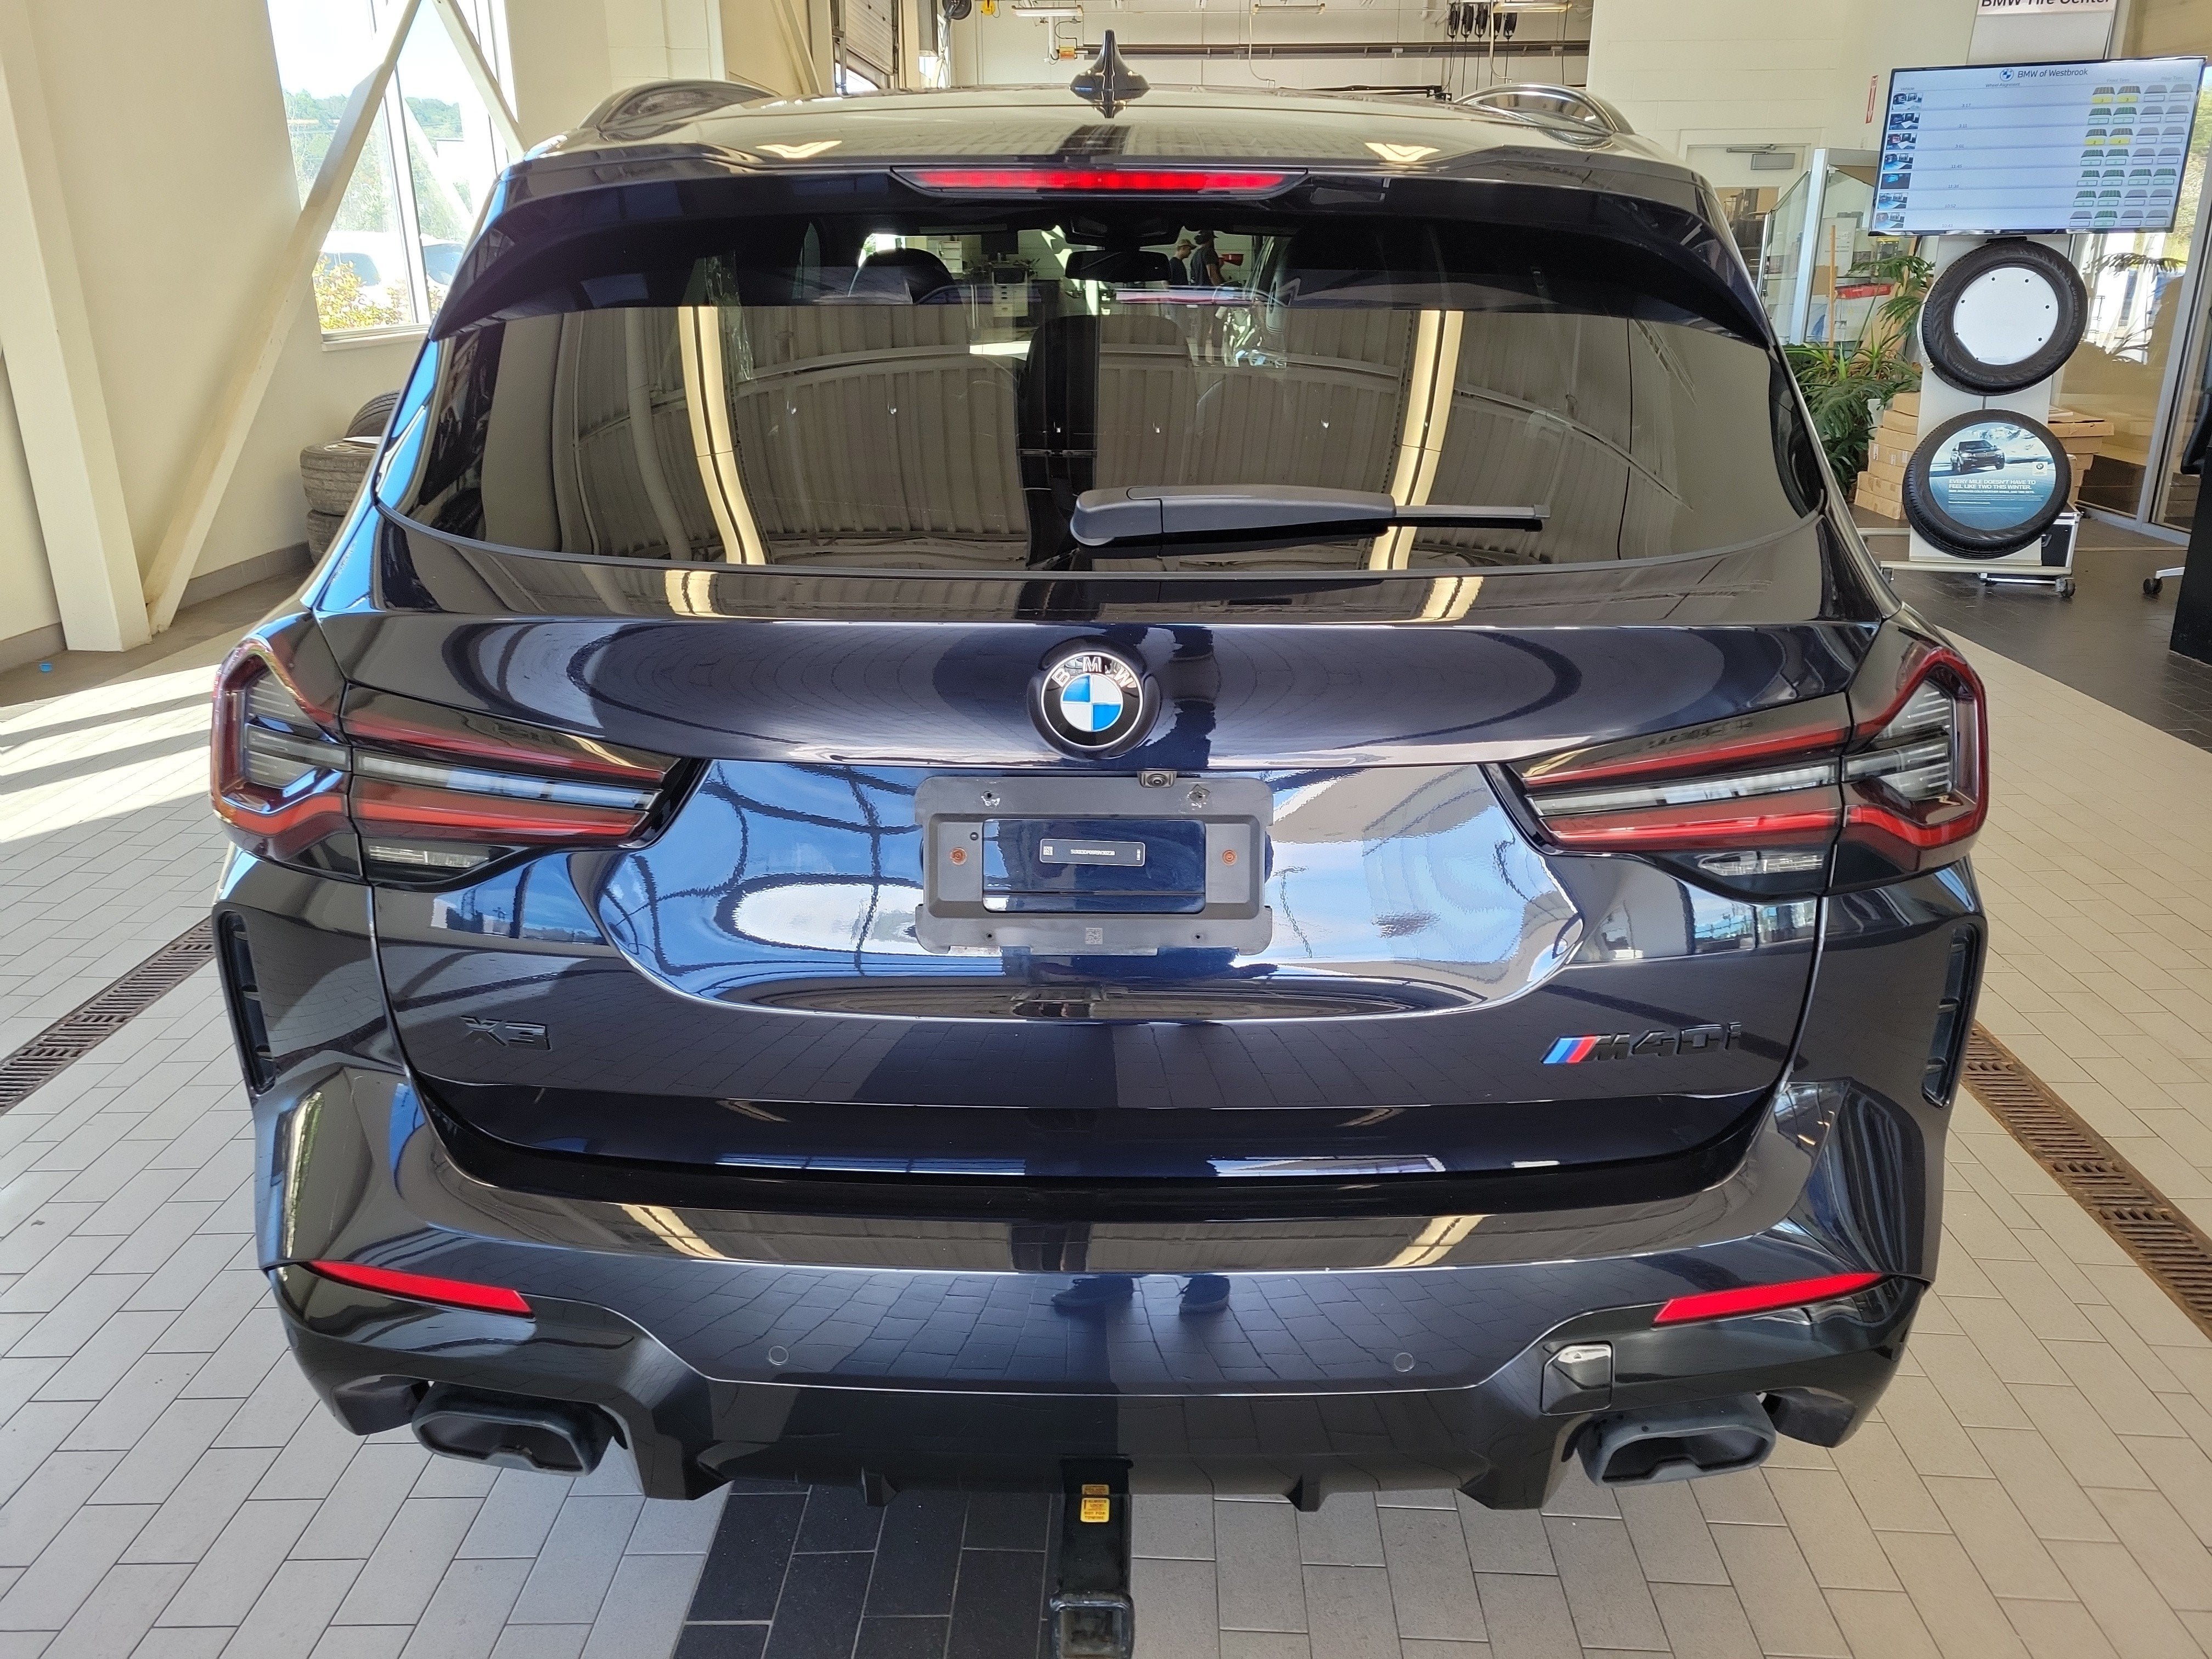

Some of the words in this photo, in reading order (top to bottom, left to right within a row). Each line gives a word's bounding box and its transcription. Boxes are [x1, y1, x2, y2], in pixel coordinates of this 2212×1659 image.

[2049, 68, 2088, 76] Westbrook
[1052, 657, 1137, 688] BMW
[460, 1015, 551, 1051] X3
